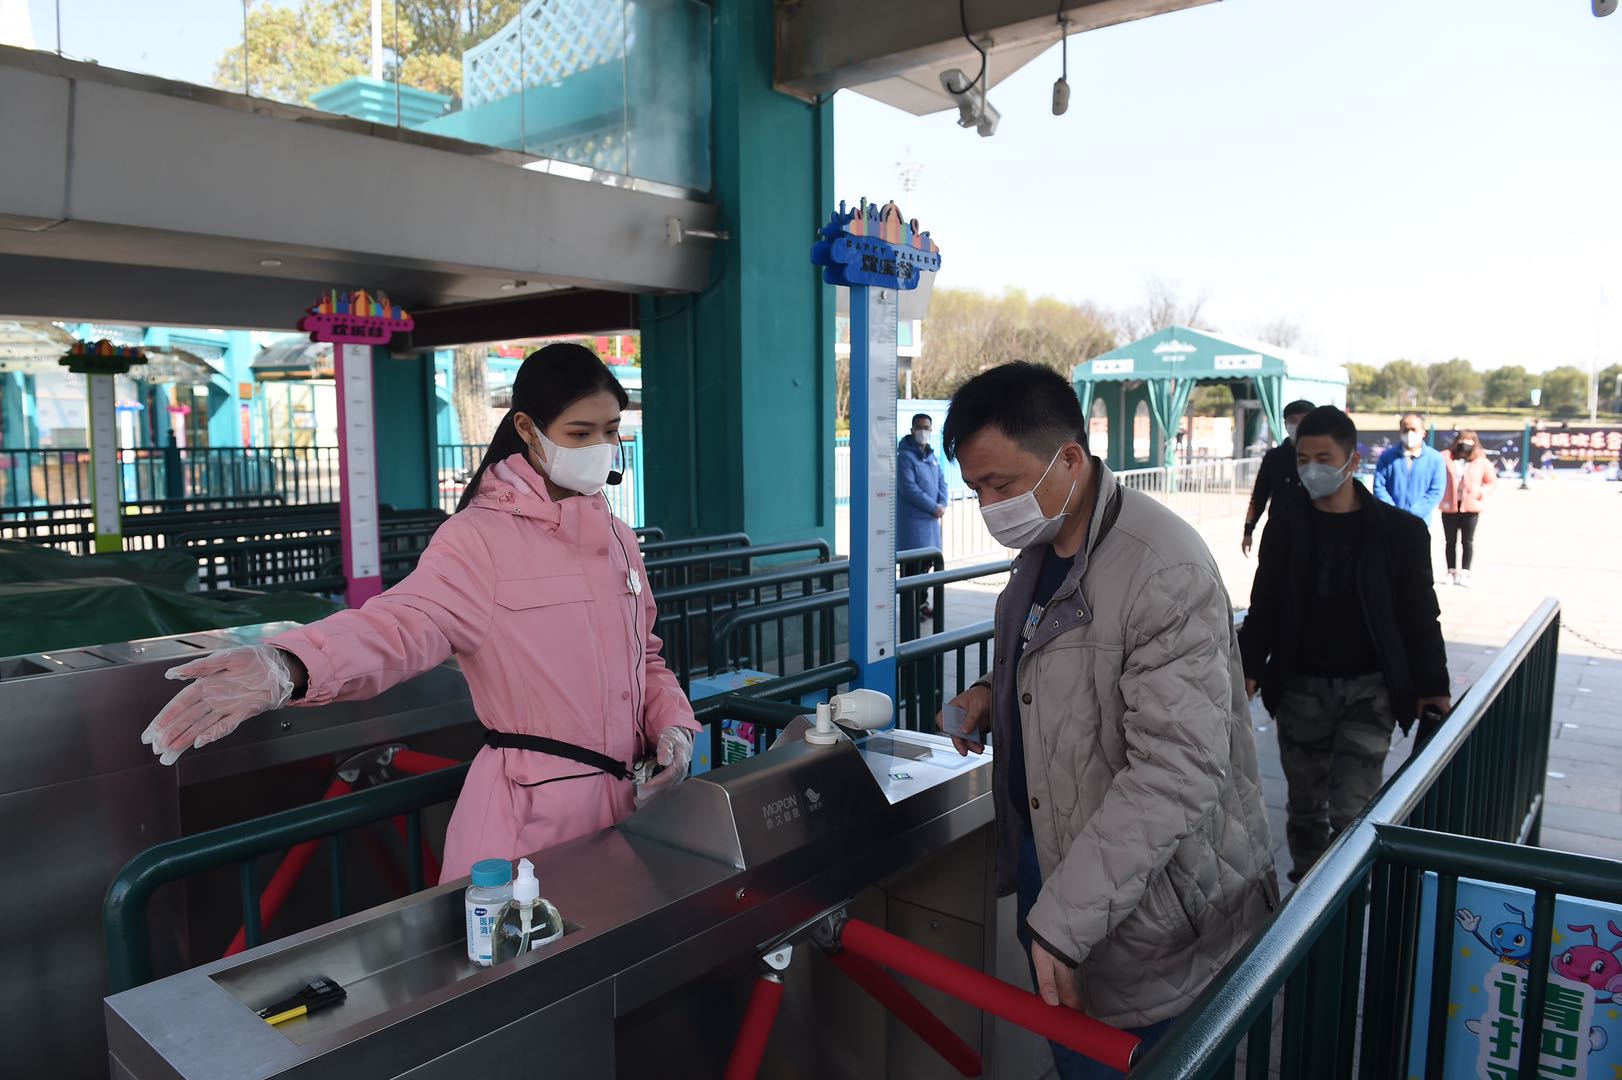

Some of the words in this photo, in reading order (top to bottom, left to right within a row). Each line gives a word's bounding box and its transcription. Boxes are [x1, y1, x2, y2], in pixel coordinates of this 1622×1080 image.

[846, 239, 887, 253] HAPPY
[893, 250, 937, 264] VALLEY
[332, 324, 383, 338] 欢乐谷
[762, 794, 797, 817] MOPON
[480, 926, 492, 935] 消
